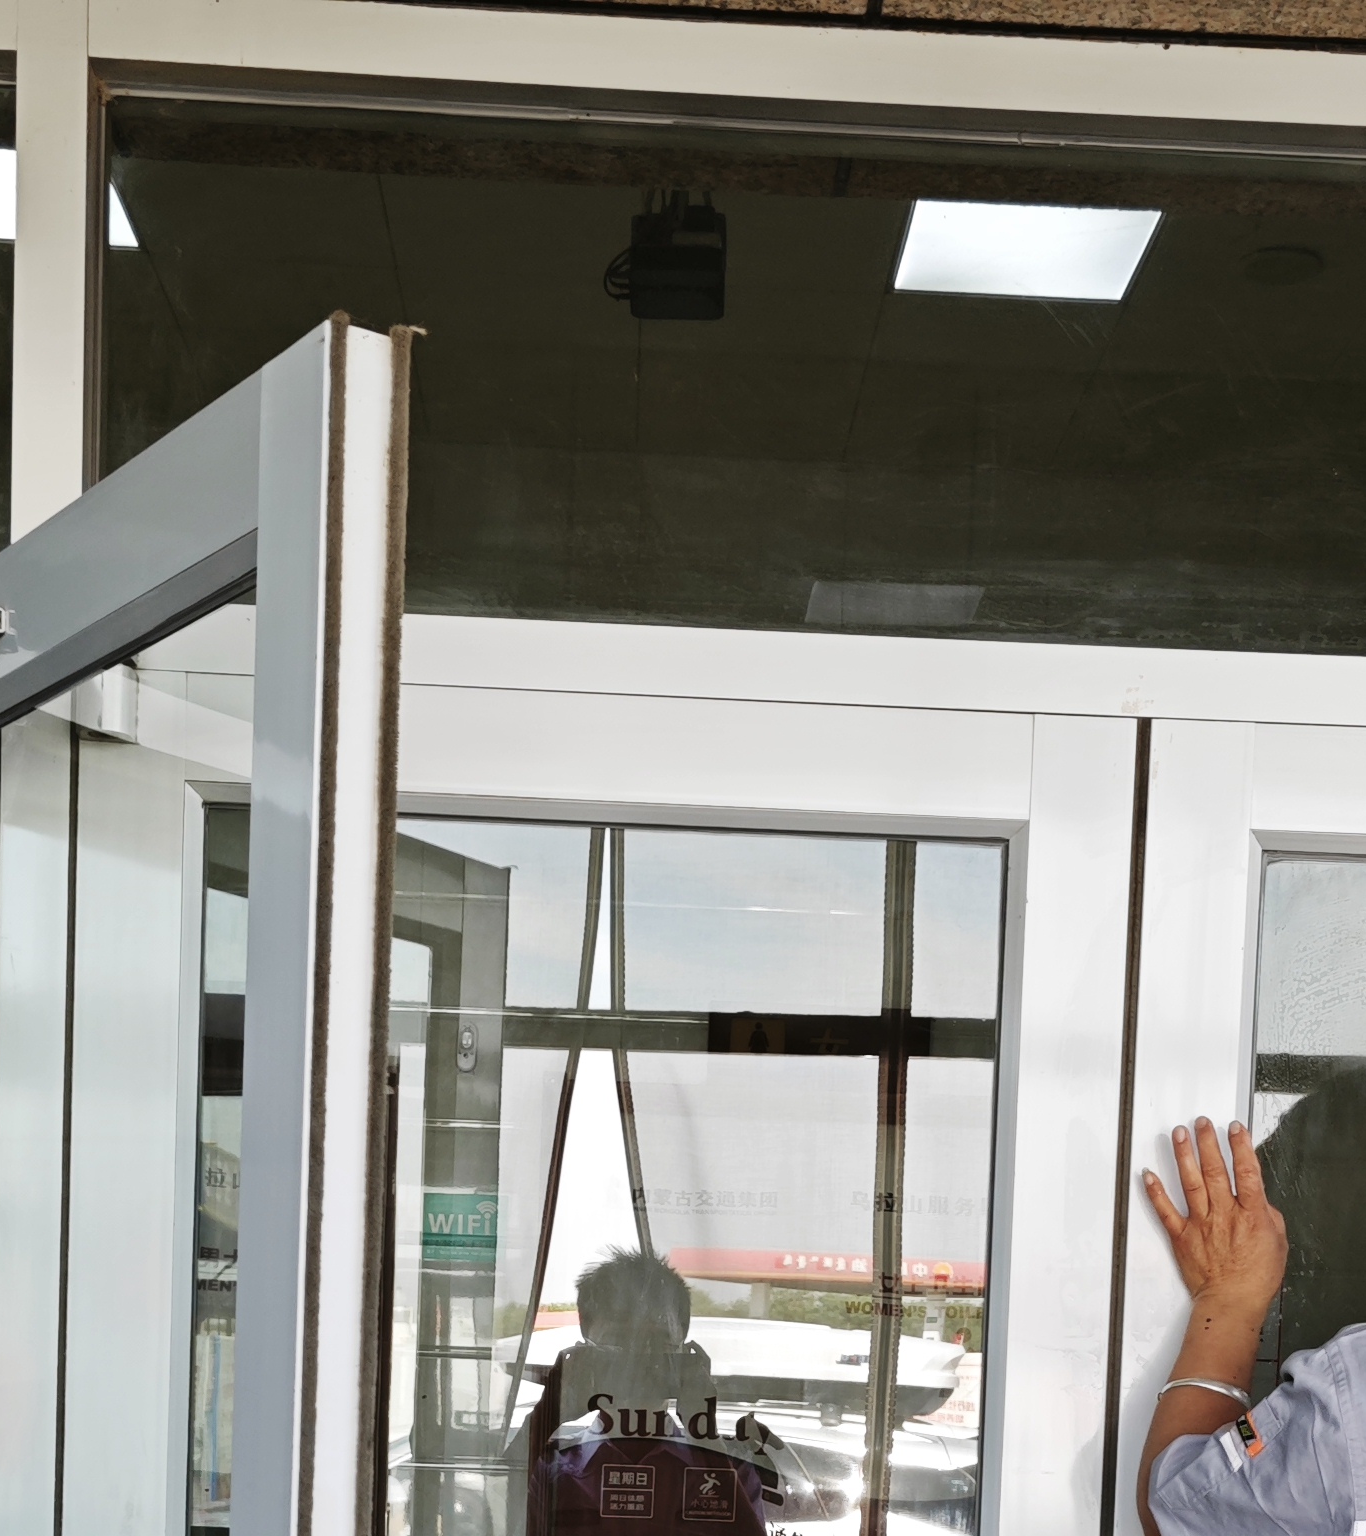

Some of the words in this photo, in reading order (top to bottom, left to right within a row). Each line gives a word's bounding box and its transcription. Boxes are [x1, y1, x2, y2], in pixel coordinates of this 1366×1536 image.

[632, 1186, 779, 1209] 内蒙古交通集团
[844, 1300, 927, 1318] WOMEN'S
[608, 1471, 648, 1486] 星期日
